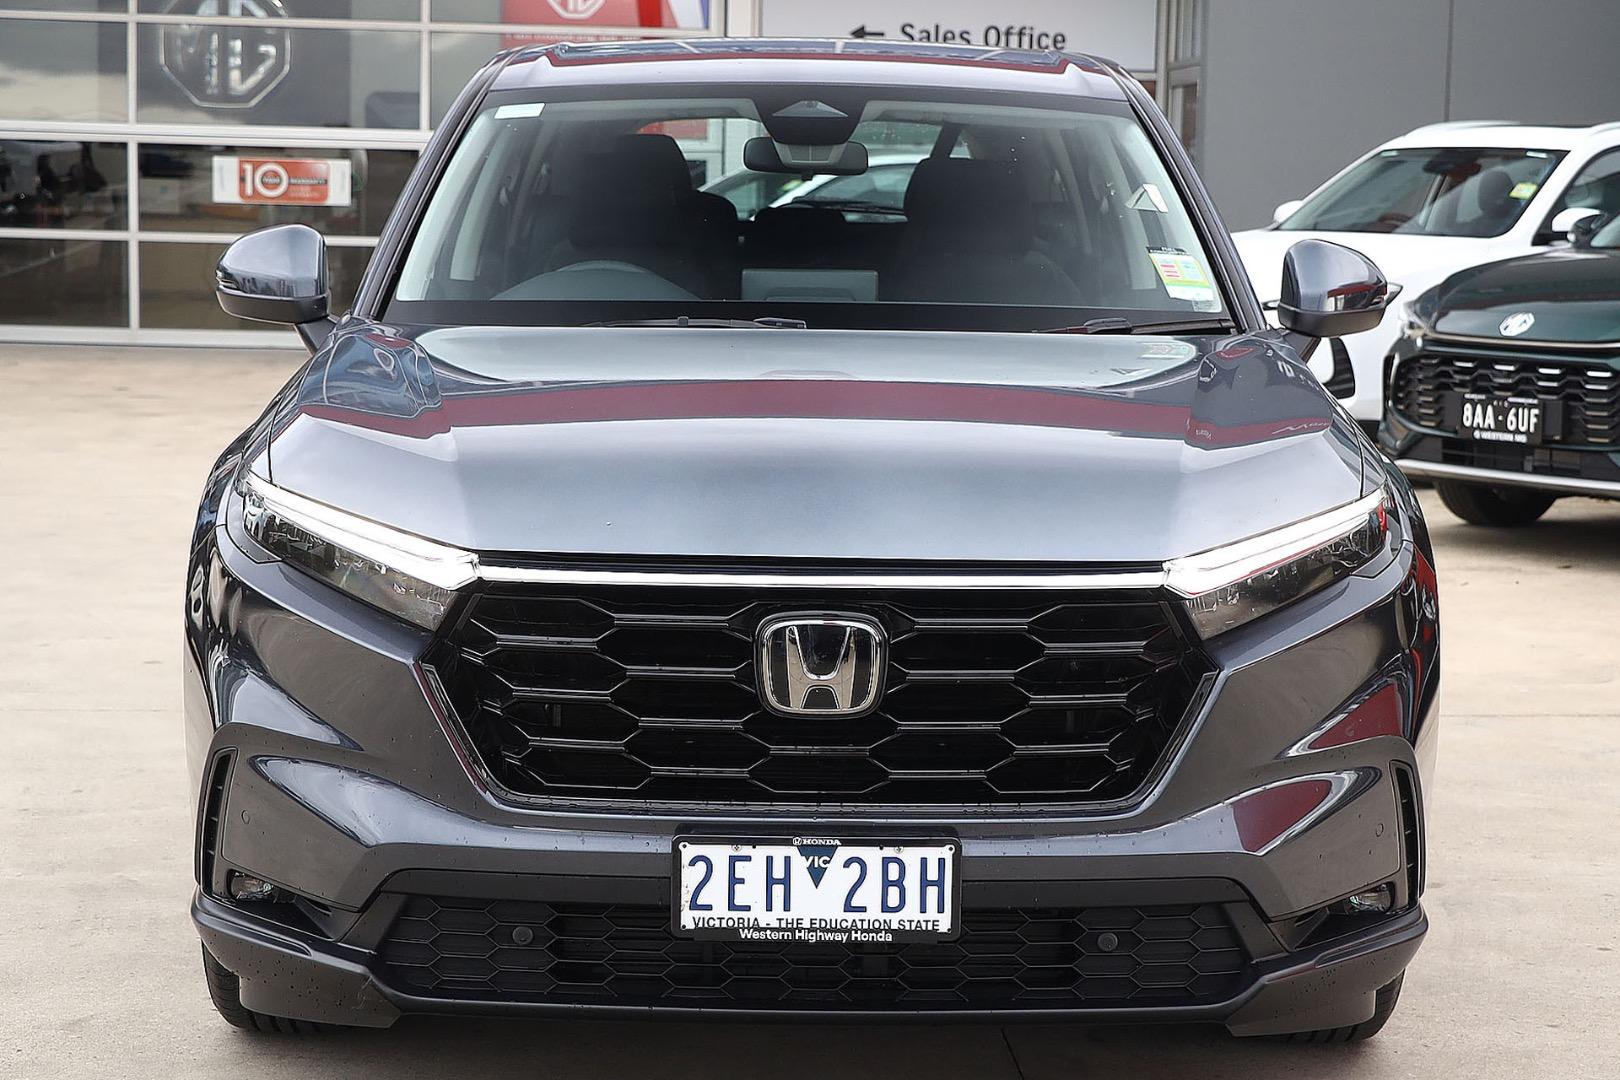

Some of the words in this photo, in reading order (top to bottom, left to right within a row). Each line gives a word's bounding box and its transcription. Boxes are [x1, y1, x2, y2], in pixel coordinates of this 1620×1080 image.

[901, 23, 970, 45] Sales
[984, 25, 1066, 50] Office
[242, 162, 289, 198] 10
[802, 855, 830, 868] VIC
[688, 855, 791, 912] 2EH
[842, 856, 946, 913] 2BH
[693, 917, 760, 929] VICTORIA
[776, 918, 804, 929] THE
[810, 918, 891, 930] EDUCATION
[898, 919, 940, 931] STATE
[739, 929, 792, 941] Western
[795, 930, 848, 943] Highway
[851, 930, 893, 942] Honda
